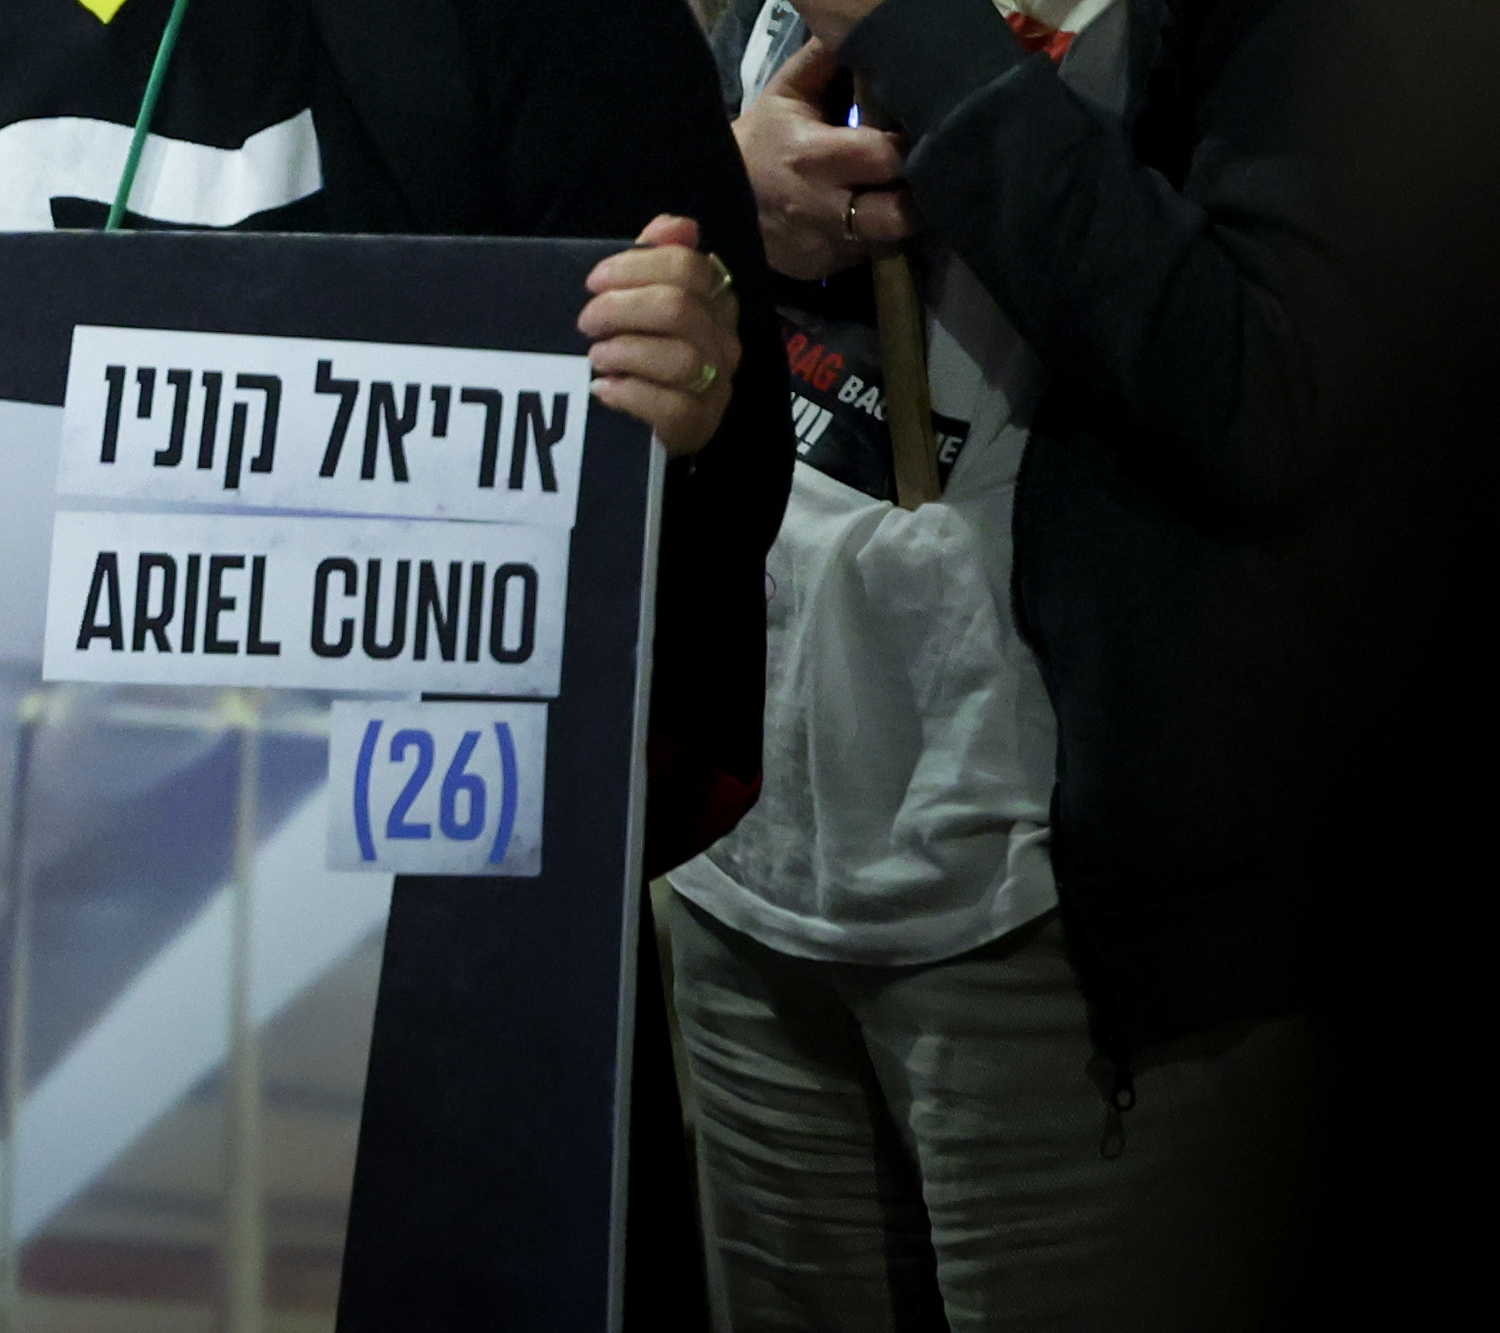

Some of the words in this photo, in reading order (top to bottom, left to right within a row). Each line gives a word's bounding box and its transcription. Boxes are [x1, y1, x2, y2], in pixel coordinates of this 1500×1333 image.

[99, 364, 283, 491] קוניו
[314, 359, 570, 493] אריאל
[75, 550, 282, 657] ARIEL
[309, 556, 538, 664] CUNIO
[352, 719, 519, 865] (26)
